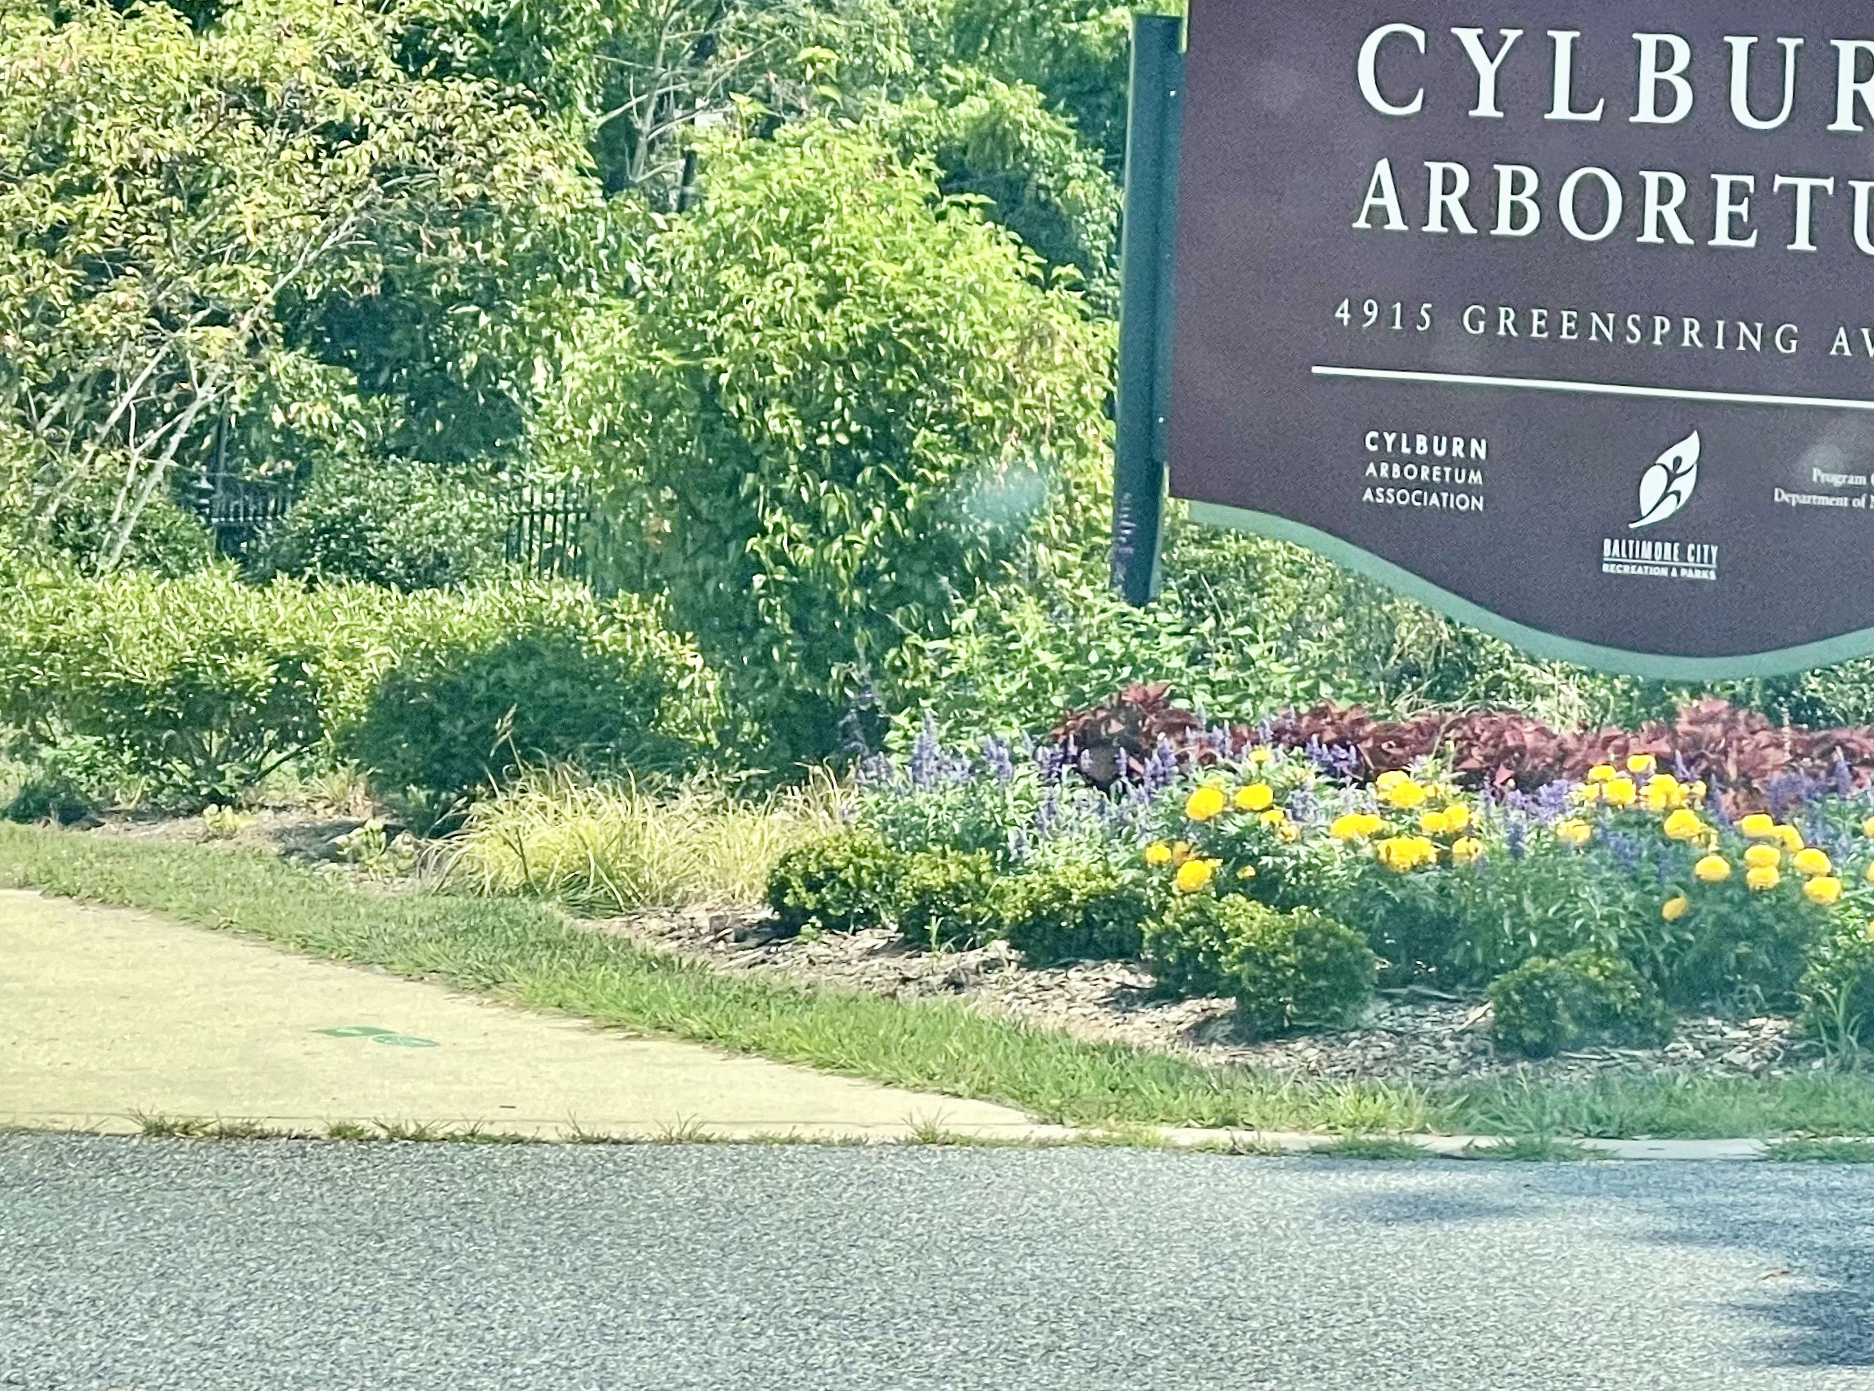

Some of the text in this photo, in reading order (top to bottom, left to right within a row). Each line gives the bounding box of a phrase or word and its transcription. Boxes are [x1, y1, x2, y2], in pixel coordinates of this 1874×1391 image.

[1333, 296, 1434, 332] 4915
[1461, 303, 1799, 355] GREENSPRING
[1364, 429, 1488, 462] CYLBURN
[1364, 460, 1484, 487] ARBORETUM
[1812, 466, 1867, 488] Program
[1361, 486, 1485, 513] ASSOCIATION
[1773, 487, 1849, 508] Department
[1851, 493, 1867, 510] of
[1602, 537, 1719, 565] BALTIMORE CITY
[1601, 562, 1669, 577] RECREATION
[1680, 567, 1717, 581] PARKS
